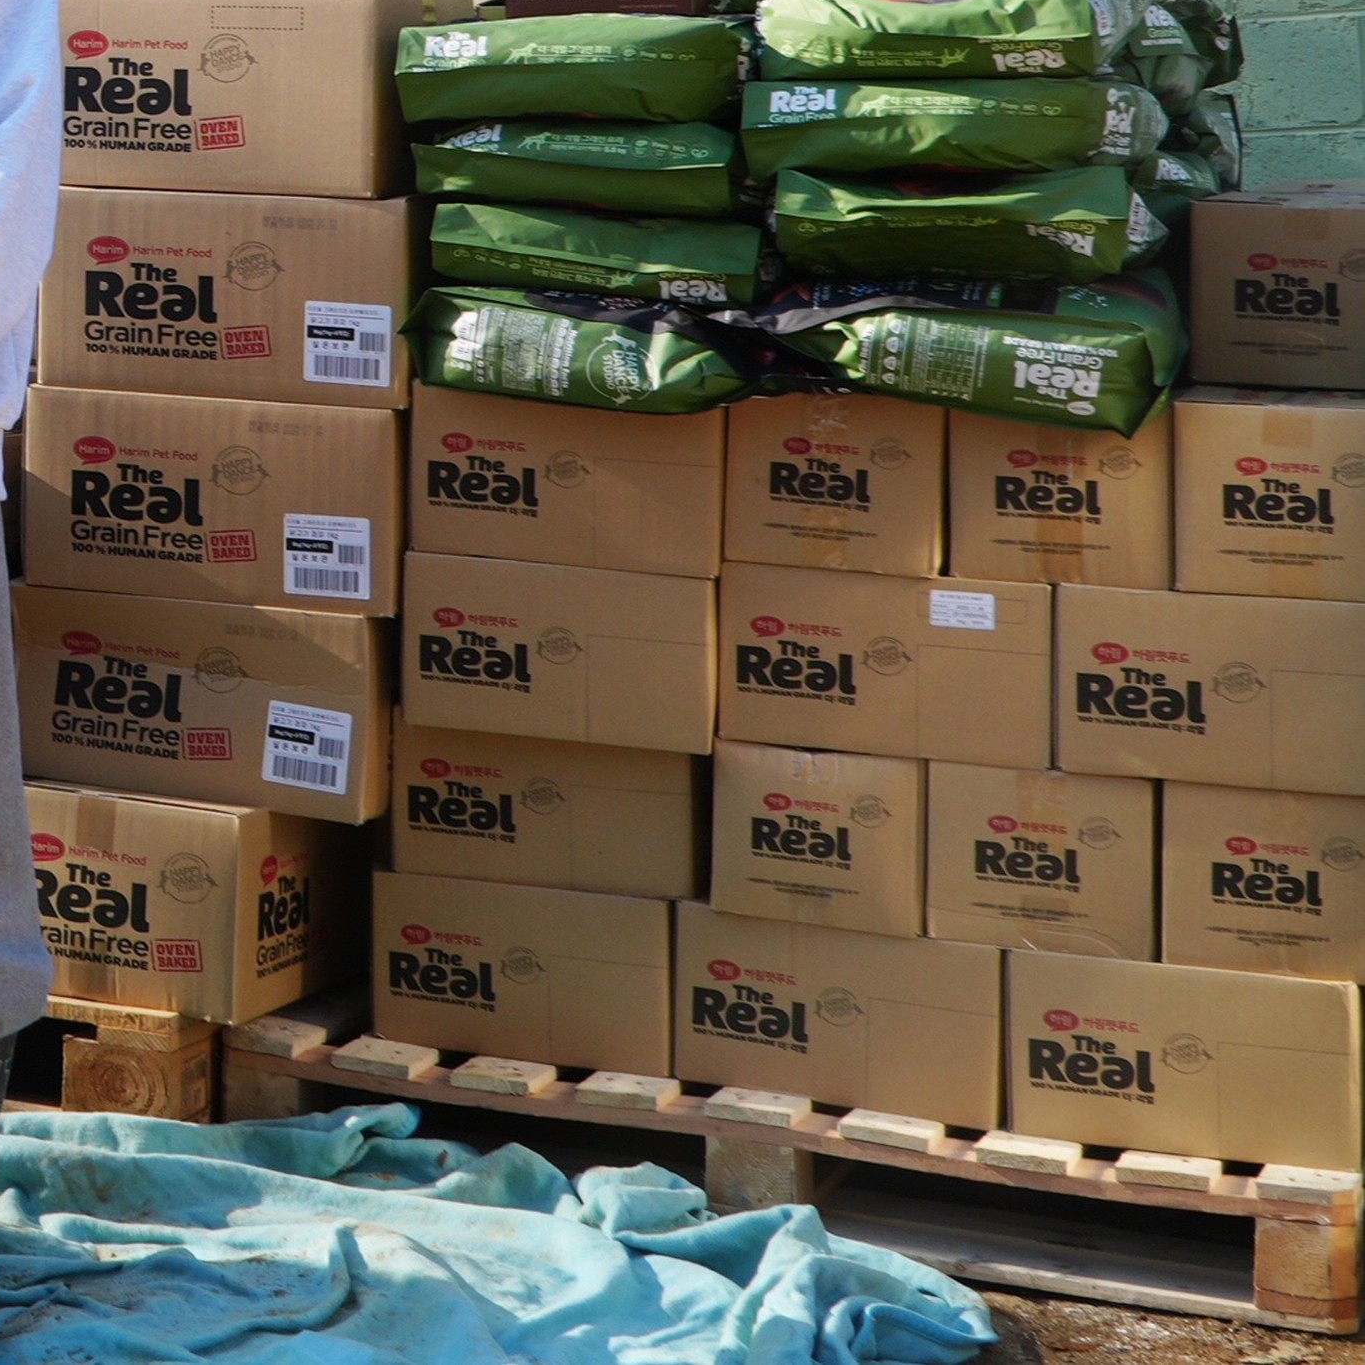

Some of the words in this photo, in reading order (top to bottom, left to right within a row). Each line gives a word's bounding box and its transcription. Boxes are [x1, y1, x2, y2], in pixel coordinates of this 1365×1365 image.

[73, 38, 102, 50] Harim
[112, 39, 142, 50] Harim
[144, 40, 161, 50] Pet
[163, 40, 189, 51] Food
[424, 35, 488, 57] Real
[109, 58, 153, 76] The
[64, 66, 192, 116] Real
[771, 88, 836, 114] Real
[793, 85, 819, 96] The
[64, 116, 130, 139] Grain
[134, 118, 192, 140] Free
[200, 121, 238, 134] OVEN
[201, 133, 240, 147] BAKED
[99, 140, 146, 152] HUMAN
[148, 142, 192, 153] GRADE
[92, 244, 124, 256] Harim
[133, 245, 164, 256] Harim
[167, 246, 184, 257] Pet
[186, 247, 212, 259] Food
[131, 262, 177, 283] The
[85, 270, 218, 324] Real
[659, 279, 727, 302] Real
[1234, 279, 1340, 317] Real
[85, 320, 154, 345] Grain
[158, 323, 218, 348] Free
[224, 330, 265, 344] OVEN
[122, 345, 170, 358] HUMAN
[173, 348, 218, 361] GRADE
[226, 342, 266, 356] BAKED
[602, 354, 614, 390] STUDIO
[613, 349, 629, 394] DANCE
[626, 347, 640, 392] HAPPY
[1014, 361, 1102, 398] Real
[117, 463, 163, 485] The
[465, 455, 505, 473] The
[427, 460, 538, 508] Real
[770, 461, 871, 504] Real
[994, 475, 1101, 515] Real
[71, 469, 203, 526] Real
[1223, 484, 1335, 525] Real
[71, 519, 140, 545] Grain
[143, 524, 203, 550] Free
[210, 533, 249, 547] OVEN
[212, 546, 251, 560] BAKED
[457, 630, 497, 648] The
[777, 640, 819, 658] The
[104, 655, 148, 679] The
[420, 634, 531, 683] Real
[736, 644, 857, 695] Real
[1120, 667, 1166, 686] The
[54, 660, 182, 723] Real
[1076, 672, 1206, 724] Real
[51, 709, 118, 739] Grain
[121, 719, 180, 746] Free
[407, 785, 516, 833] Real
[751, 817, 852, 861] Real
[66, 863, 111, 887] The
[974, 840, 1080, 884] Real
[1211, 861, 1323, 907] Real
[35, 868, 150, 933] Real
[40, 923, 86, 949] rain
[90, 930, 149, 956] Free
[157, 943, 196, 957] OVEN
[158, 956, 198, 970] BAKED
[388, 951, 496, 1002] Real
[732, 984, 774, 1005] The
[692, 986, 809, 1043] Real
[1071, 1035, 1116, 1055] The
[1028, 1038, 1155, 1094] Real
